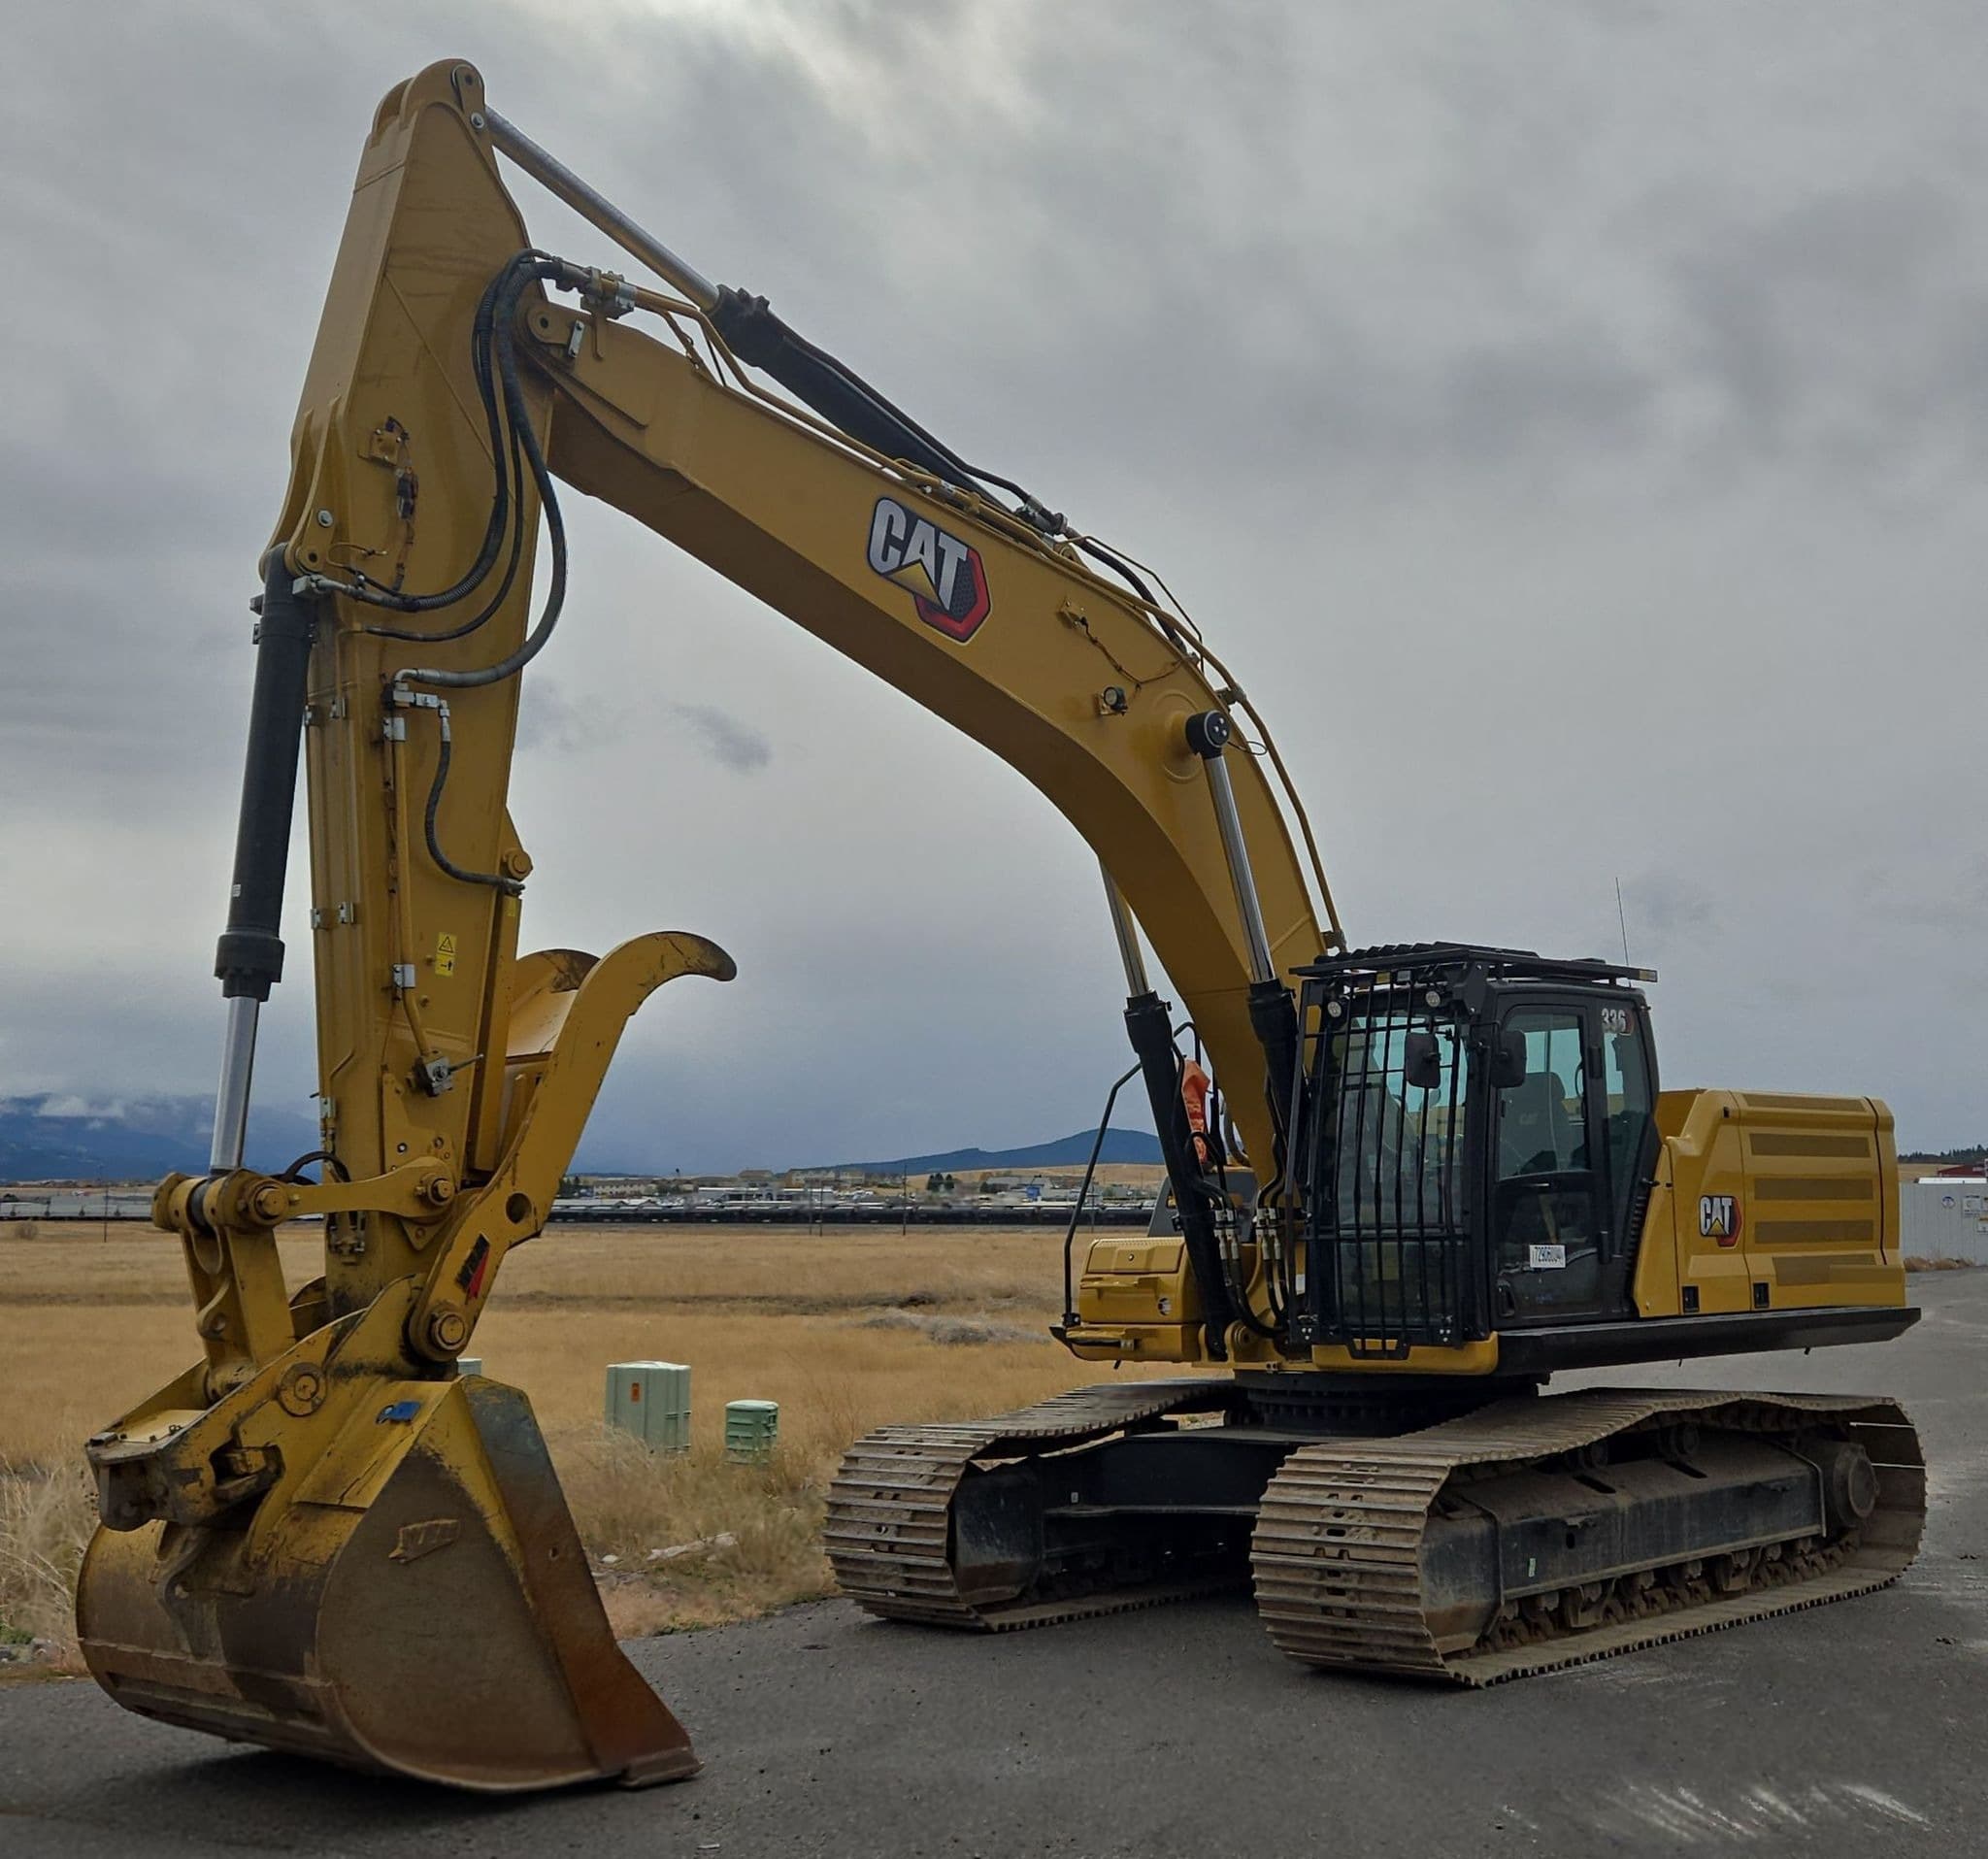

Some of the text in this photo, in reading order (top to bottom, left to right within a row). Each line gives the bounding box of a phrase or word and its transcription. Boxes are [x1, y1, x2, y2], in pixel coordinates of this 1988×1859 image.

[870, 499, 968, 611] CAT
[1602, 1008, 1626, 1033] 336
[1701, 1196, 1733, 1235] CAT
